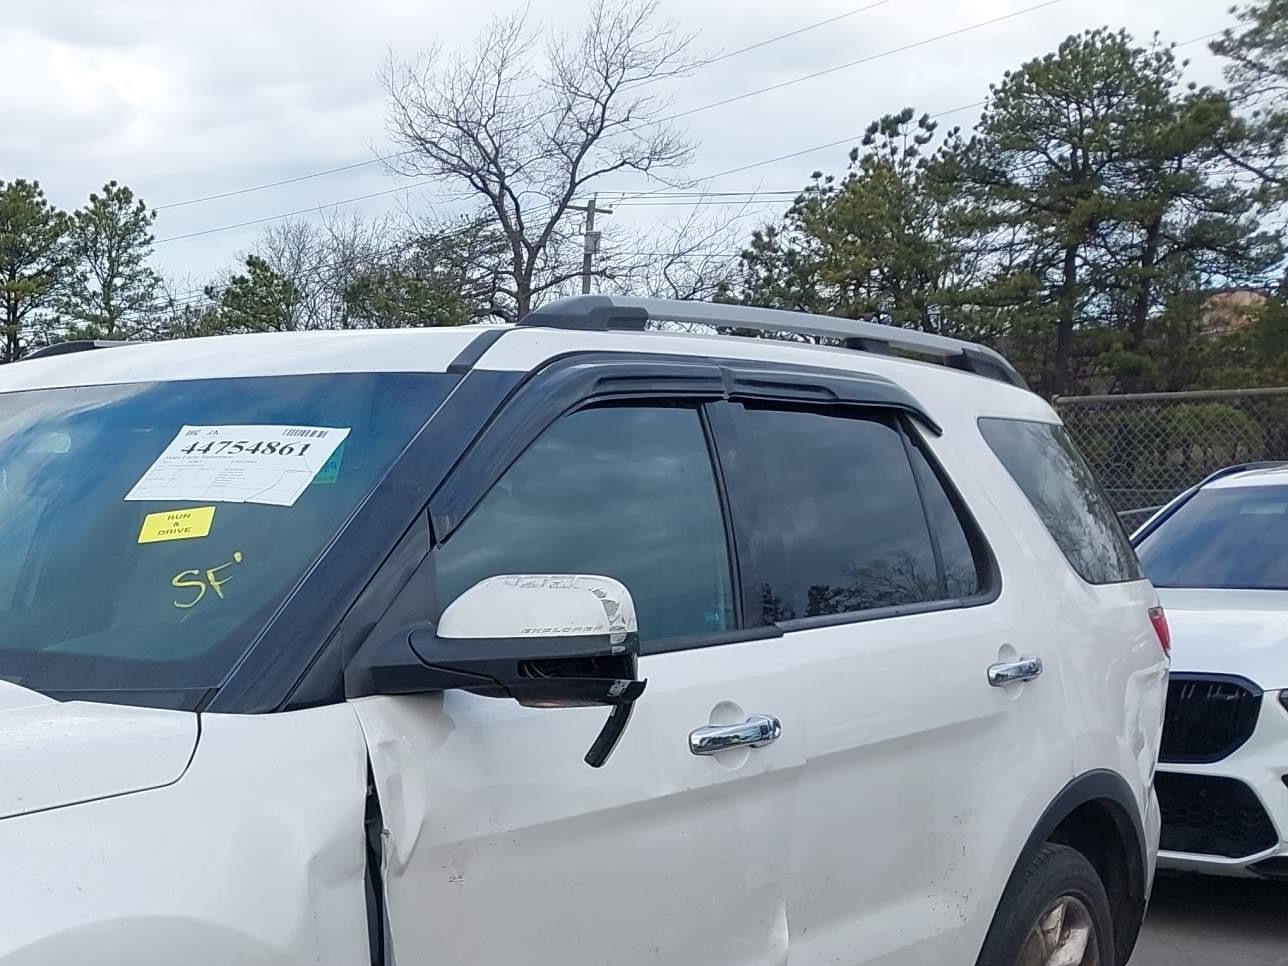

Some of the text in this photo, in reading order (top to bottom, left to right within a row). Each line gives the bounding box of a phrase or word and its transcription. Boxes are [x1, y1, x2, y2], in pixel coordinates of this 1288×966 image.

[180, 440, 312, 457] 44754861
[167, 513, 192, 521] RUN
[157, 527, 193, 536] DRIVE
[520, 625, 605, 634] EXPLORER
